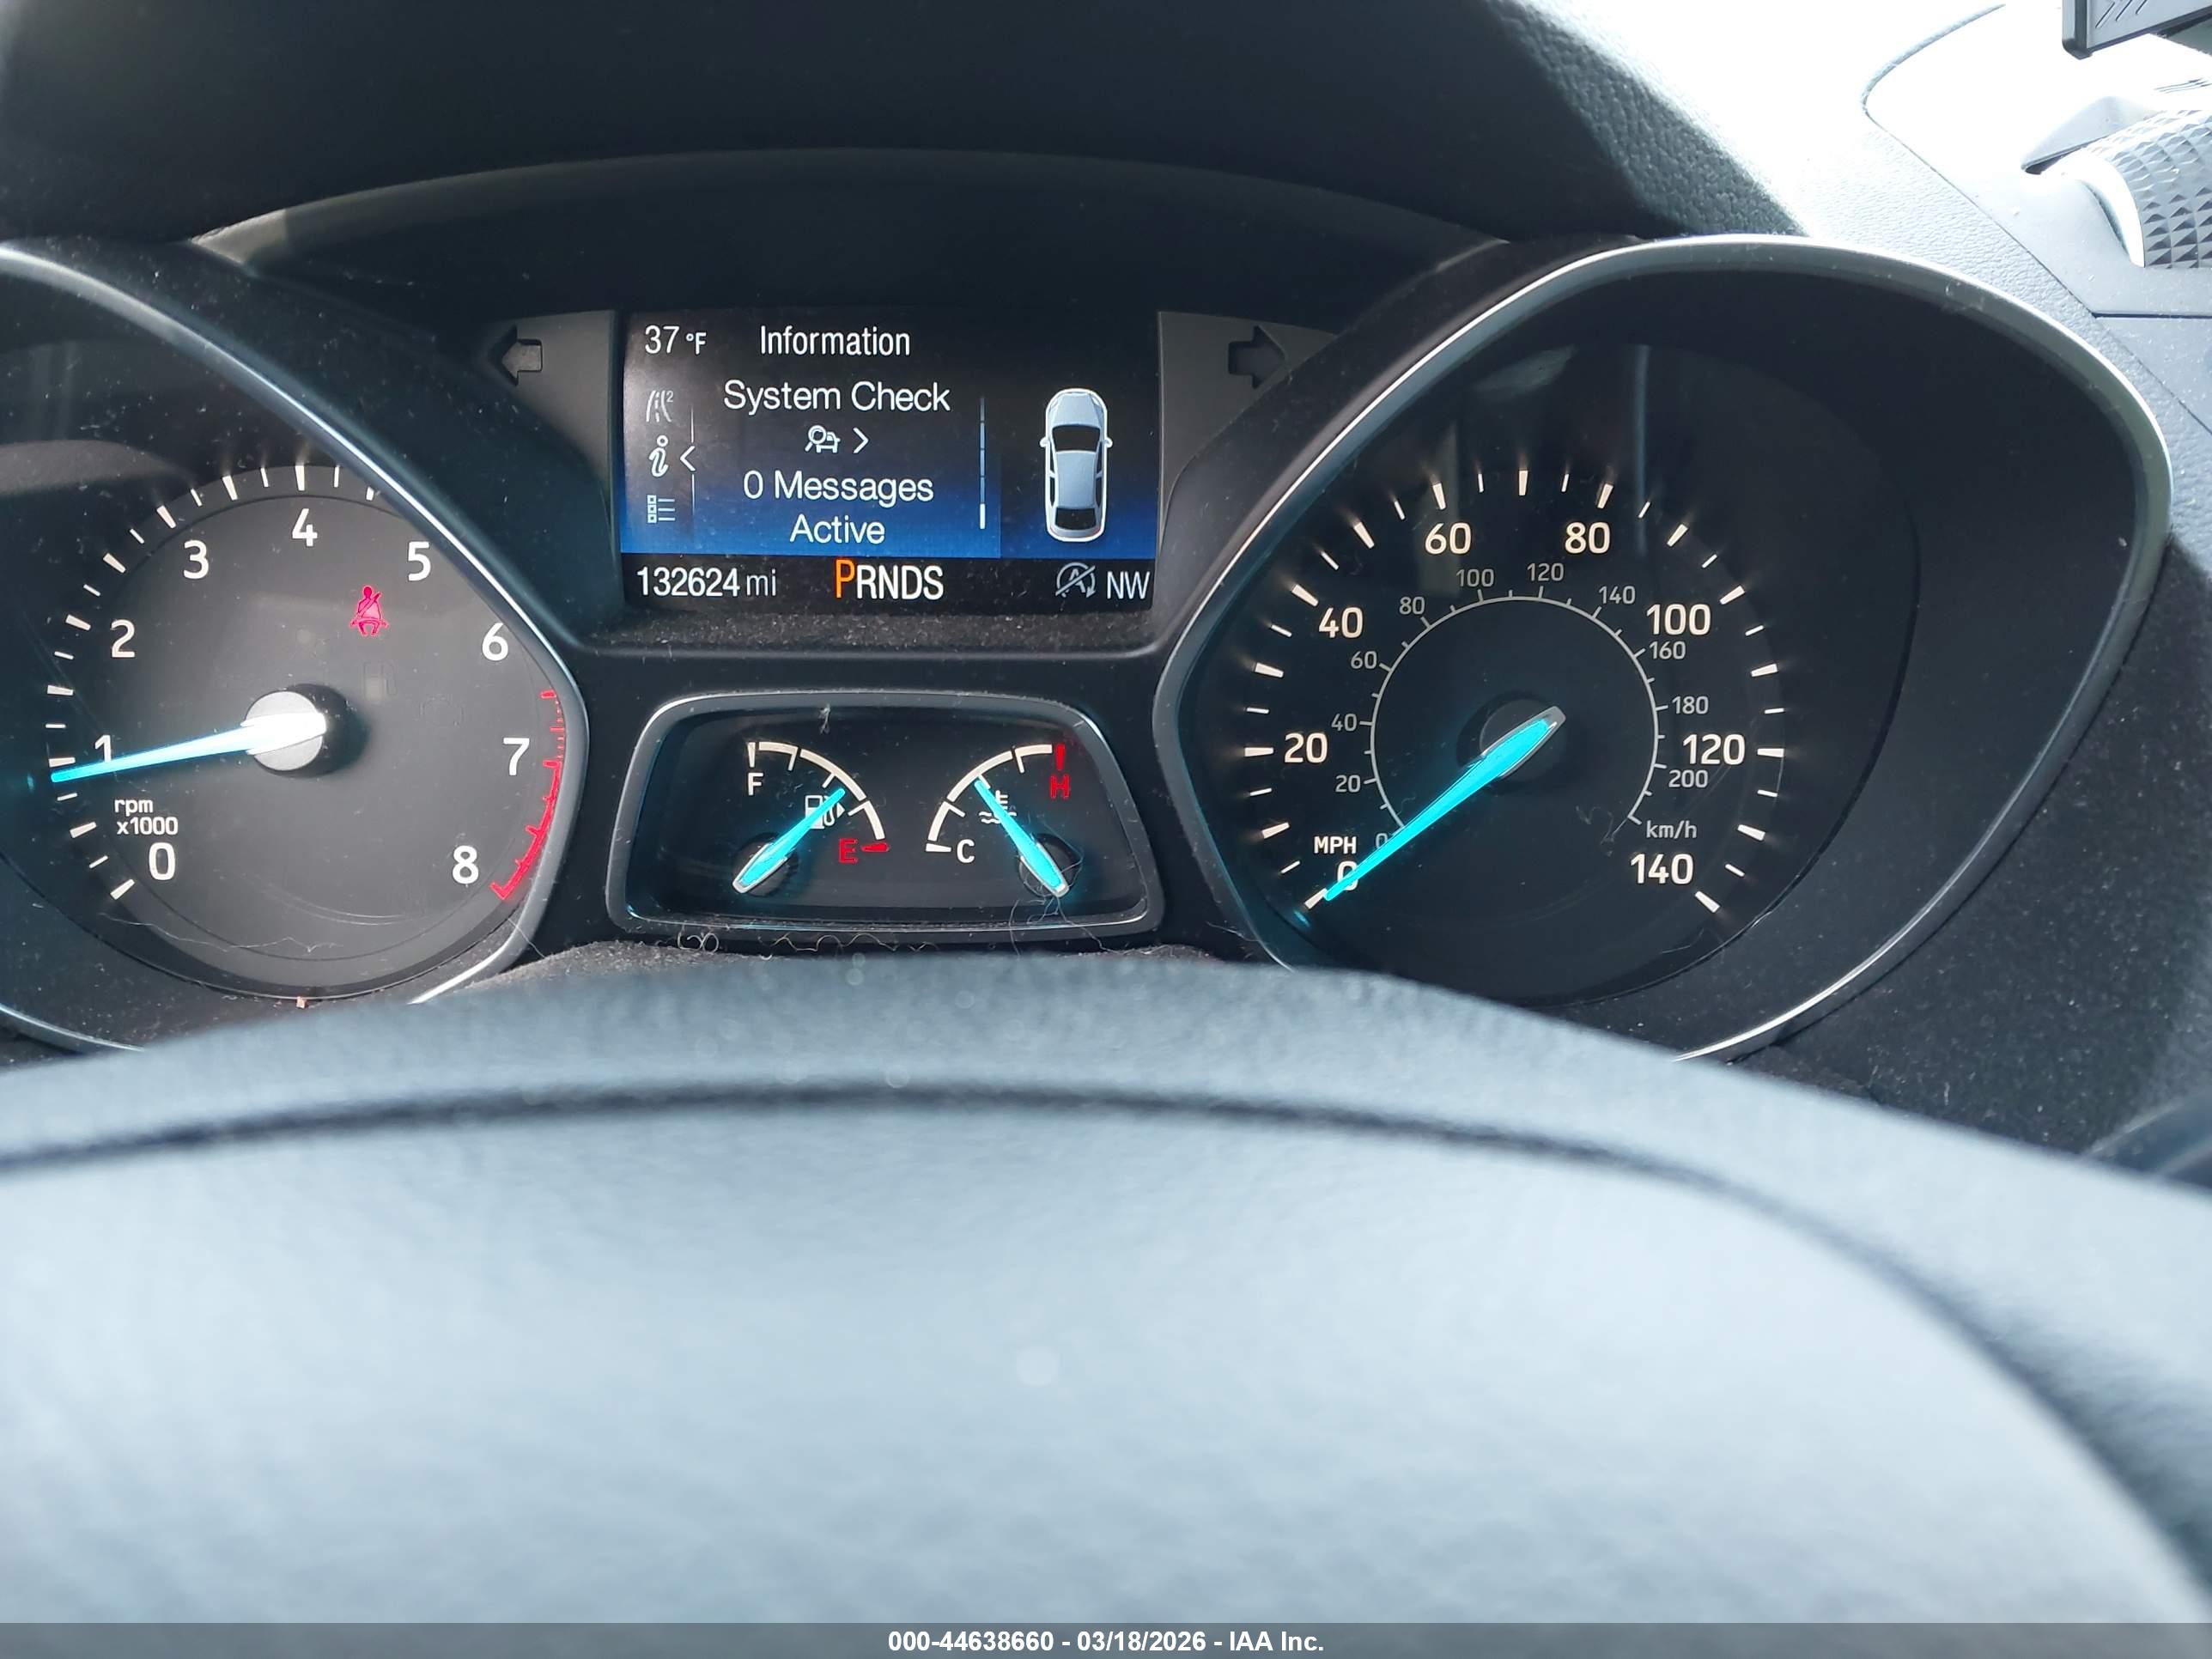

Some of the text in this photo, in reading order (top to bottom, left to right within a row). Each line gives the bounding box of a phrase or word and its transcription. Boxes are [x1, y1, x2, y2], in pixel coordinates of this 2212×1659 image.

[644, 326, 678, 354] 37
[760, 326, 910, 356] Information
[724, 380, 950, 415] System Check
[744, 471, 933, 506] 0 Messages
[292, 509, 317, 546] 4
[790, 515, 884, 544] Active
[1425, 523, 1471, 554] 60
[1565, 523, 1610, 554] 80
[183, 540, 208, 579] 3
[408, 542, 430, 580] 5
[1528, 563, 1564, 580] 120
[636, 568, 776, 596] 132624 mi
[835, 559, 944, 599] PRNDS
[1108, 572, 1150, 599] NW
[1456, 569, 1494, 586] 100
[1399, 597, 1425, 614] 80
[1599, 586, 1635, 604] 140
[1319, 608, 1363, 637] 40
[1646, 605, 1711, 635] 100
[112, 621, 135, 657] 2
[483, 623, 508, 660] 6
[1650, 642, 1686, 659] 160
[1351, 651, 1376, 669] 60
[1672, 696, 1708, 714] 180
[1331, 714, 1357, 731] 40
[94, 735, 112, 761] 1
[503, 738, 529, 775] 7
[1285, 733, 1328, 763] 20
[1683, 734, 1745, 764] 120
[749, 773, 763, 795] F
[1051, 775, 1070, 797] H
[1335, 775, 1361, 793] 20
[1668, 770, 1708, 787] 200
[114, 798, 153, 815] rpm
[117, 817, 178, 835] x1000
[1646, 821, 1697, 840] km/h
[840, 840, 857, 863] E
[957, 840, 975, 863] C
[1314, 836, 1356, 854] MPH
[149, 842, 175, 880] 0
[453, 846, 478, 883] 8
[1632, 854, 1693, 884] 140
